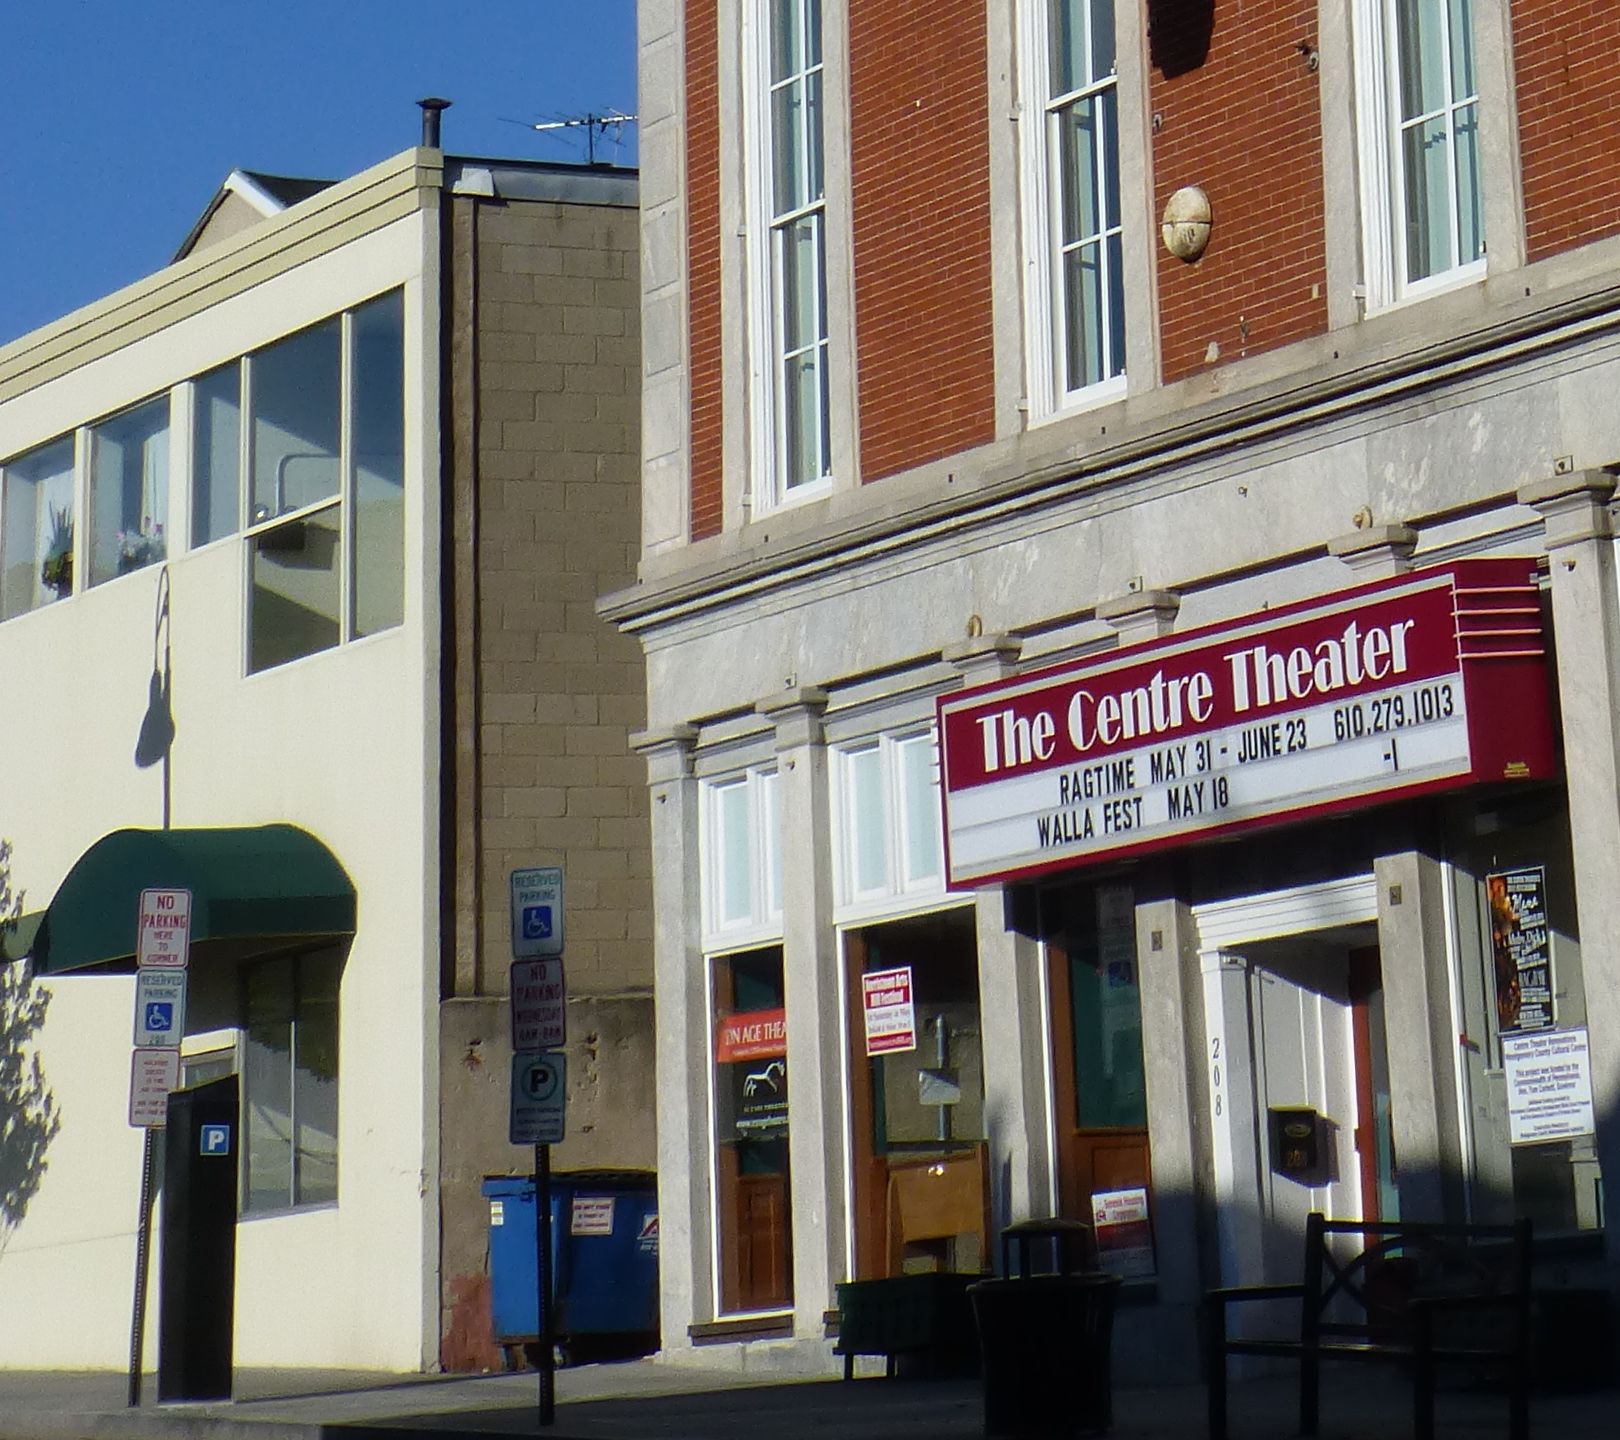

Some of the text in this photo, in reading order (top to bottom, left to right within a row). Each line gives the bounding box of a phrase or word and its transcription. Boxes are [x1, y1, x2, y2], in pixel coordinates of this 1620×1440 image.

[976, 619, 1415, 773] The Centre Theater
[1060, 758, 1135, 805] RAGTIME
[1151, 744, 1187, 784] MAY
[1196, 739, 1211, 771] 31
[1238, 723, 1281, 764] JUNE
[1286, 718, 1308, 753] 23
[1334, 684, 1454, 742] 610.279.1013
[1037, 776, 1229, 848] WALLA FEST MAY 18
[157, 896, 174, 909] NO
[142, 914, 187, 928] PARKING
[531, 964, 547, 980] NO
[516, 984, 560, 1000] PARKING
[531, 1069, 549, 1093] P
[1212, 1037, 1222, 1117] 208
[207, 1130, 225, 1150] P
